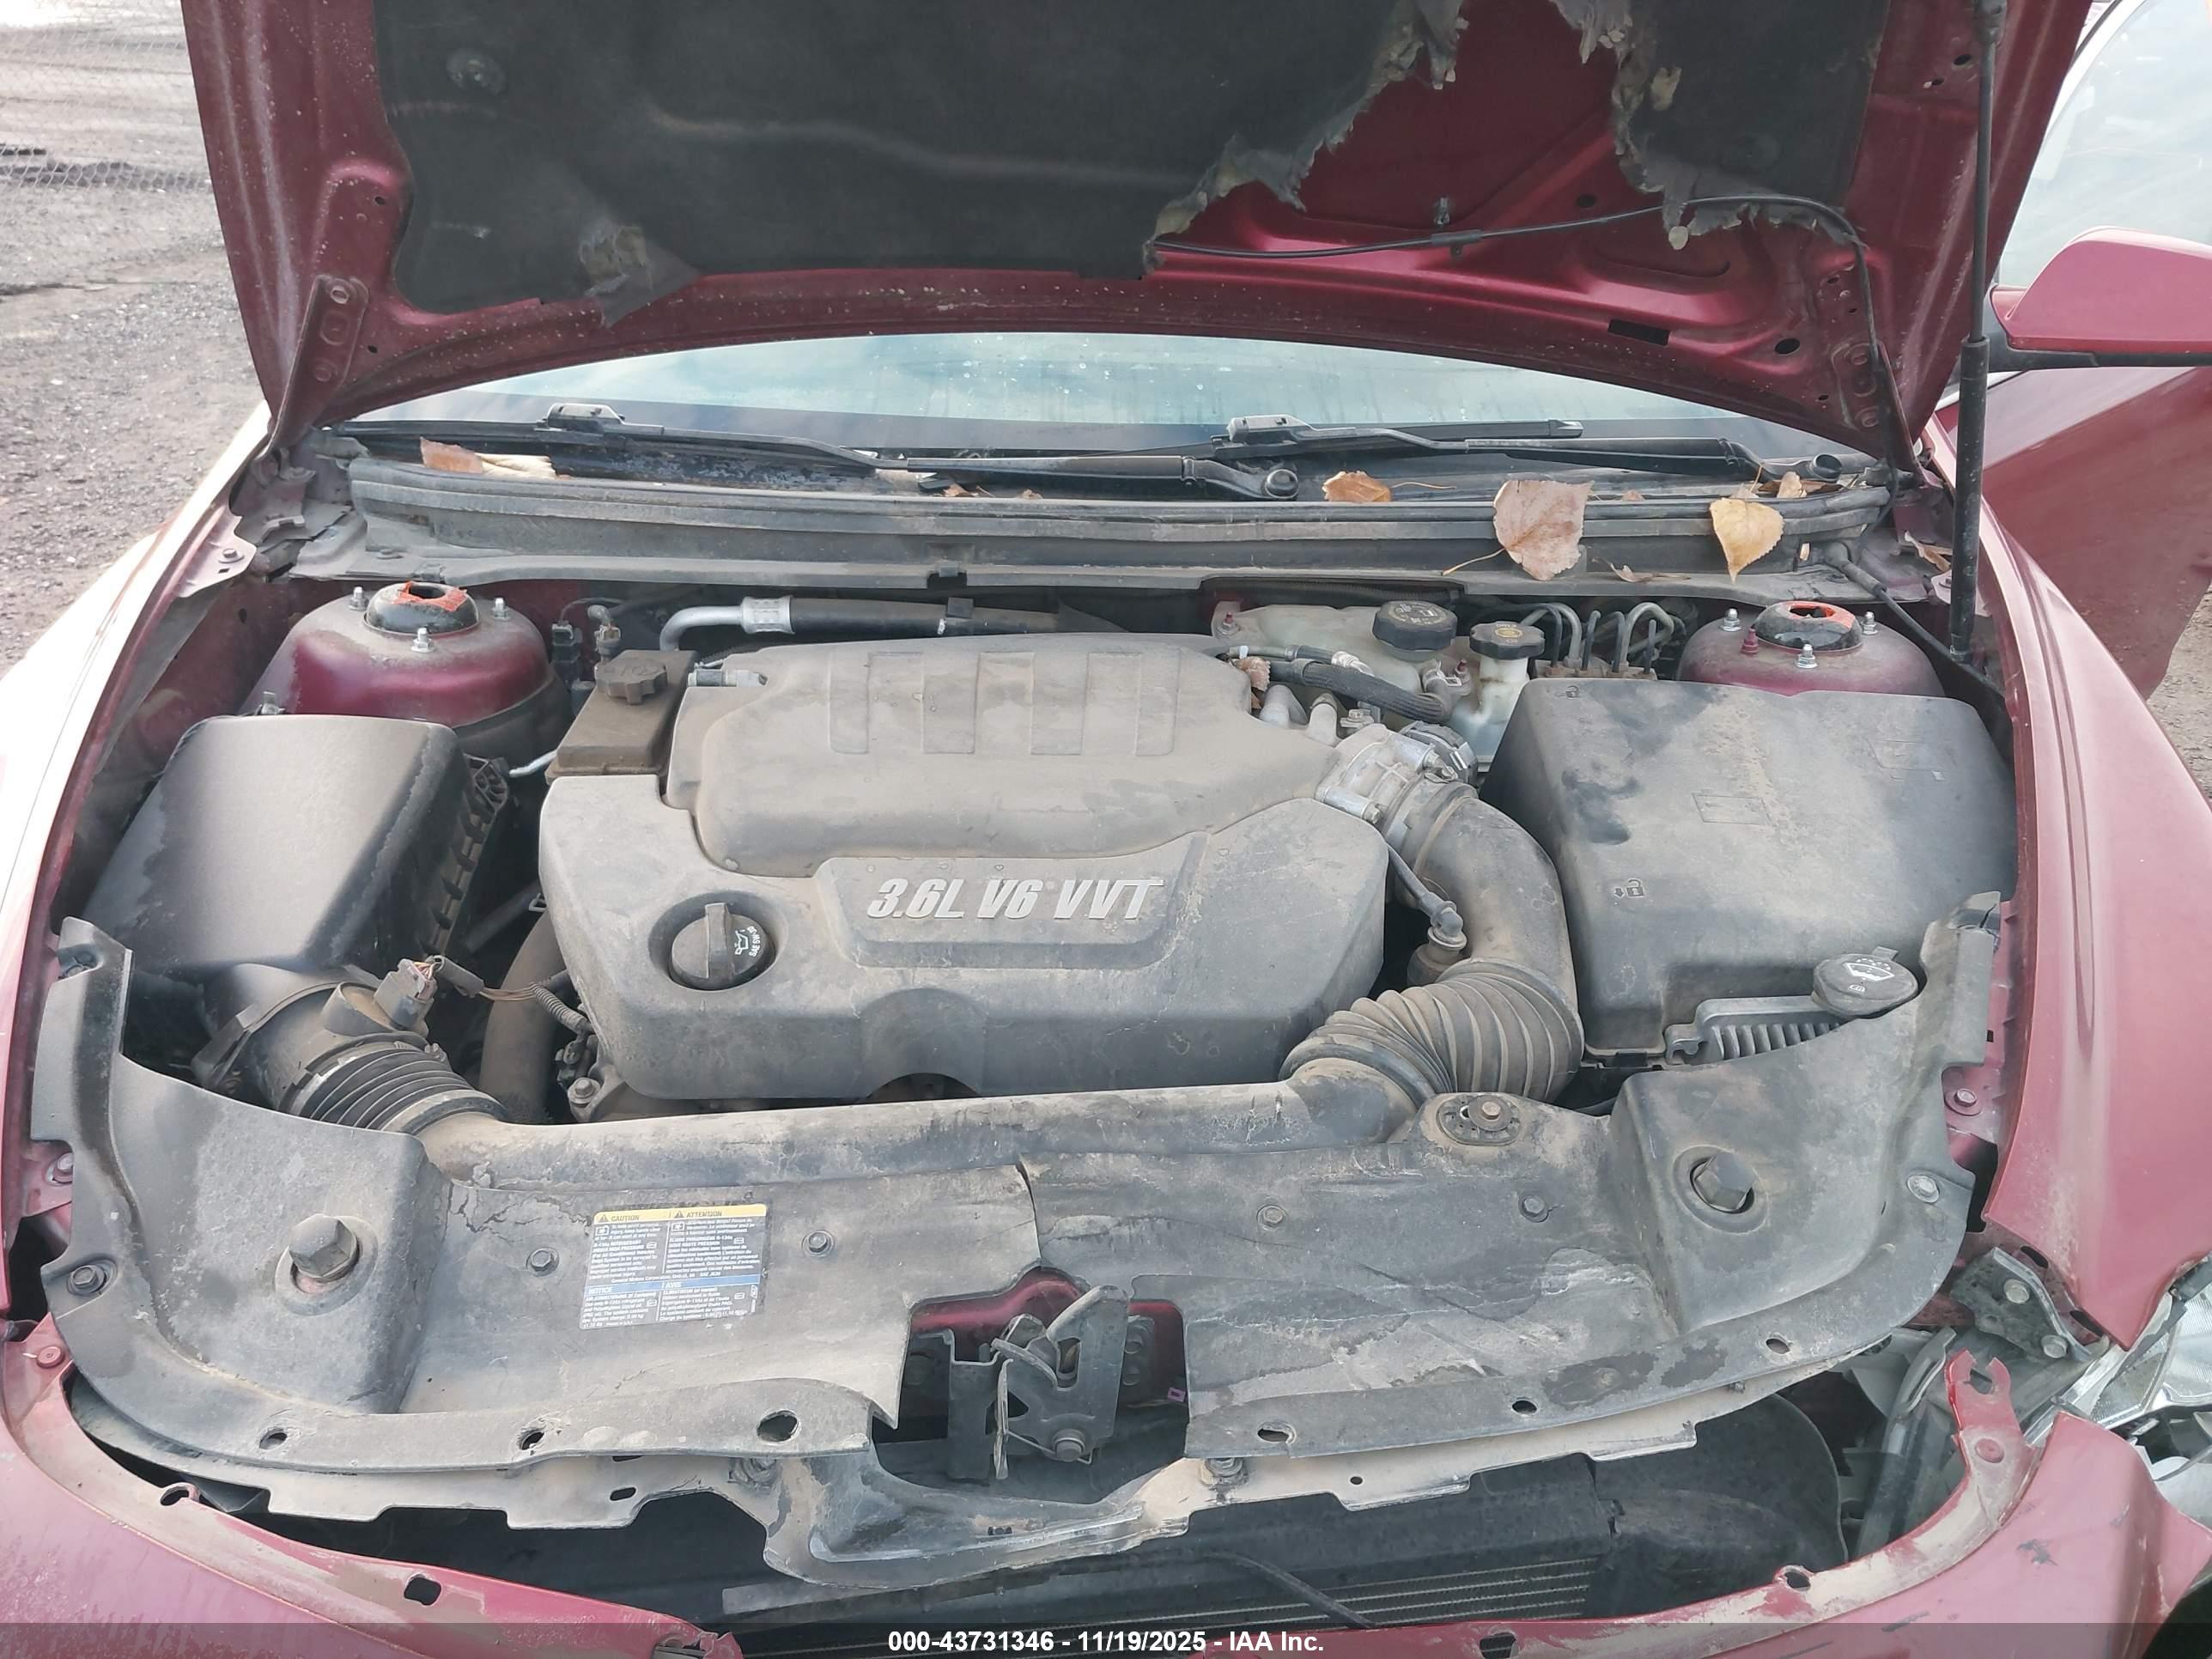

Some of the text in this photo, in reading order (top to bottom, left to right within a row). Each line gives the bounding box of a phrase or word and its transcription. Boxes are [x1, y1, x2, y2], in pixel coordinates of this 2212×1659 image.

[866, 878, 1164, 920] 3.6L V6 VVT
[748, 945, 761, 957] SAE
